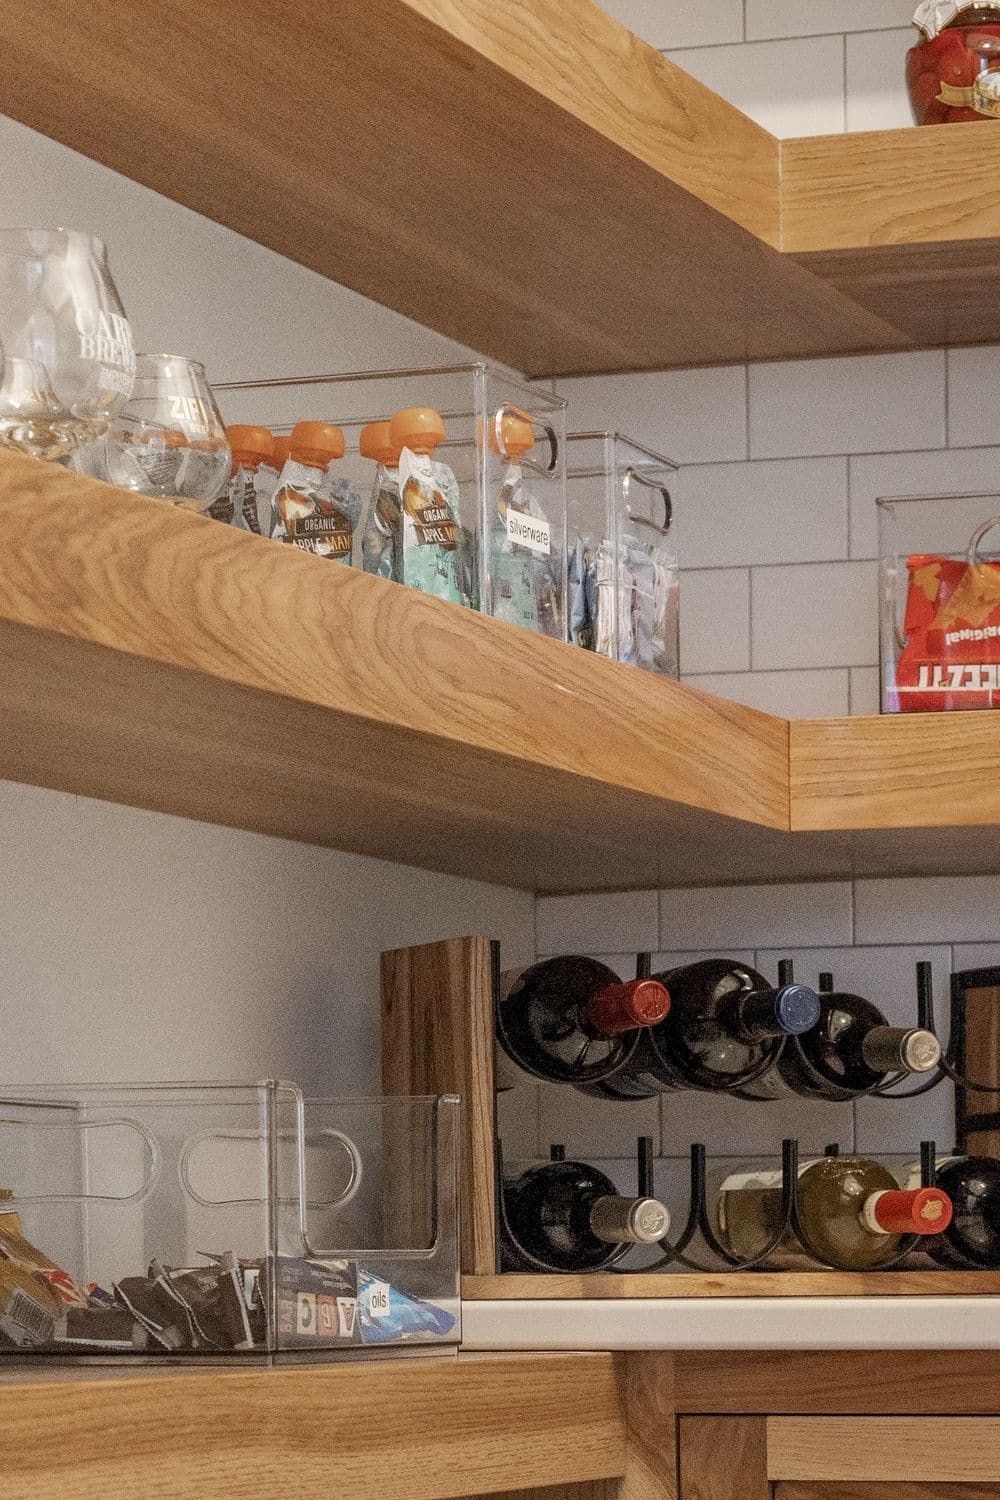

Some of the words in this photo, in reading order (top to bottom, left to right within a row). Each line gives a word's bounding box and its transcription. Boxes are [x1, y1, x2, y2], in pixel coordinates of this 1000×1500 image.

[304, 517, 336, 531] ORGANIC
[422, 528, 447, 543] APPLE
[509, 520, 549, 546] silverware
[371, 1290, 387, 1309] oils
